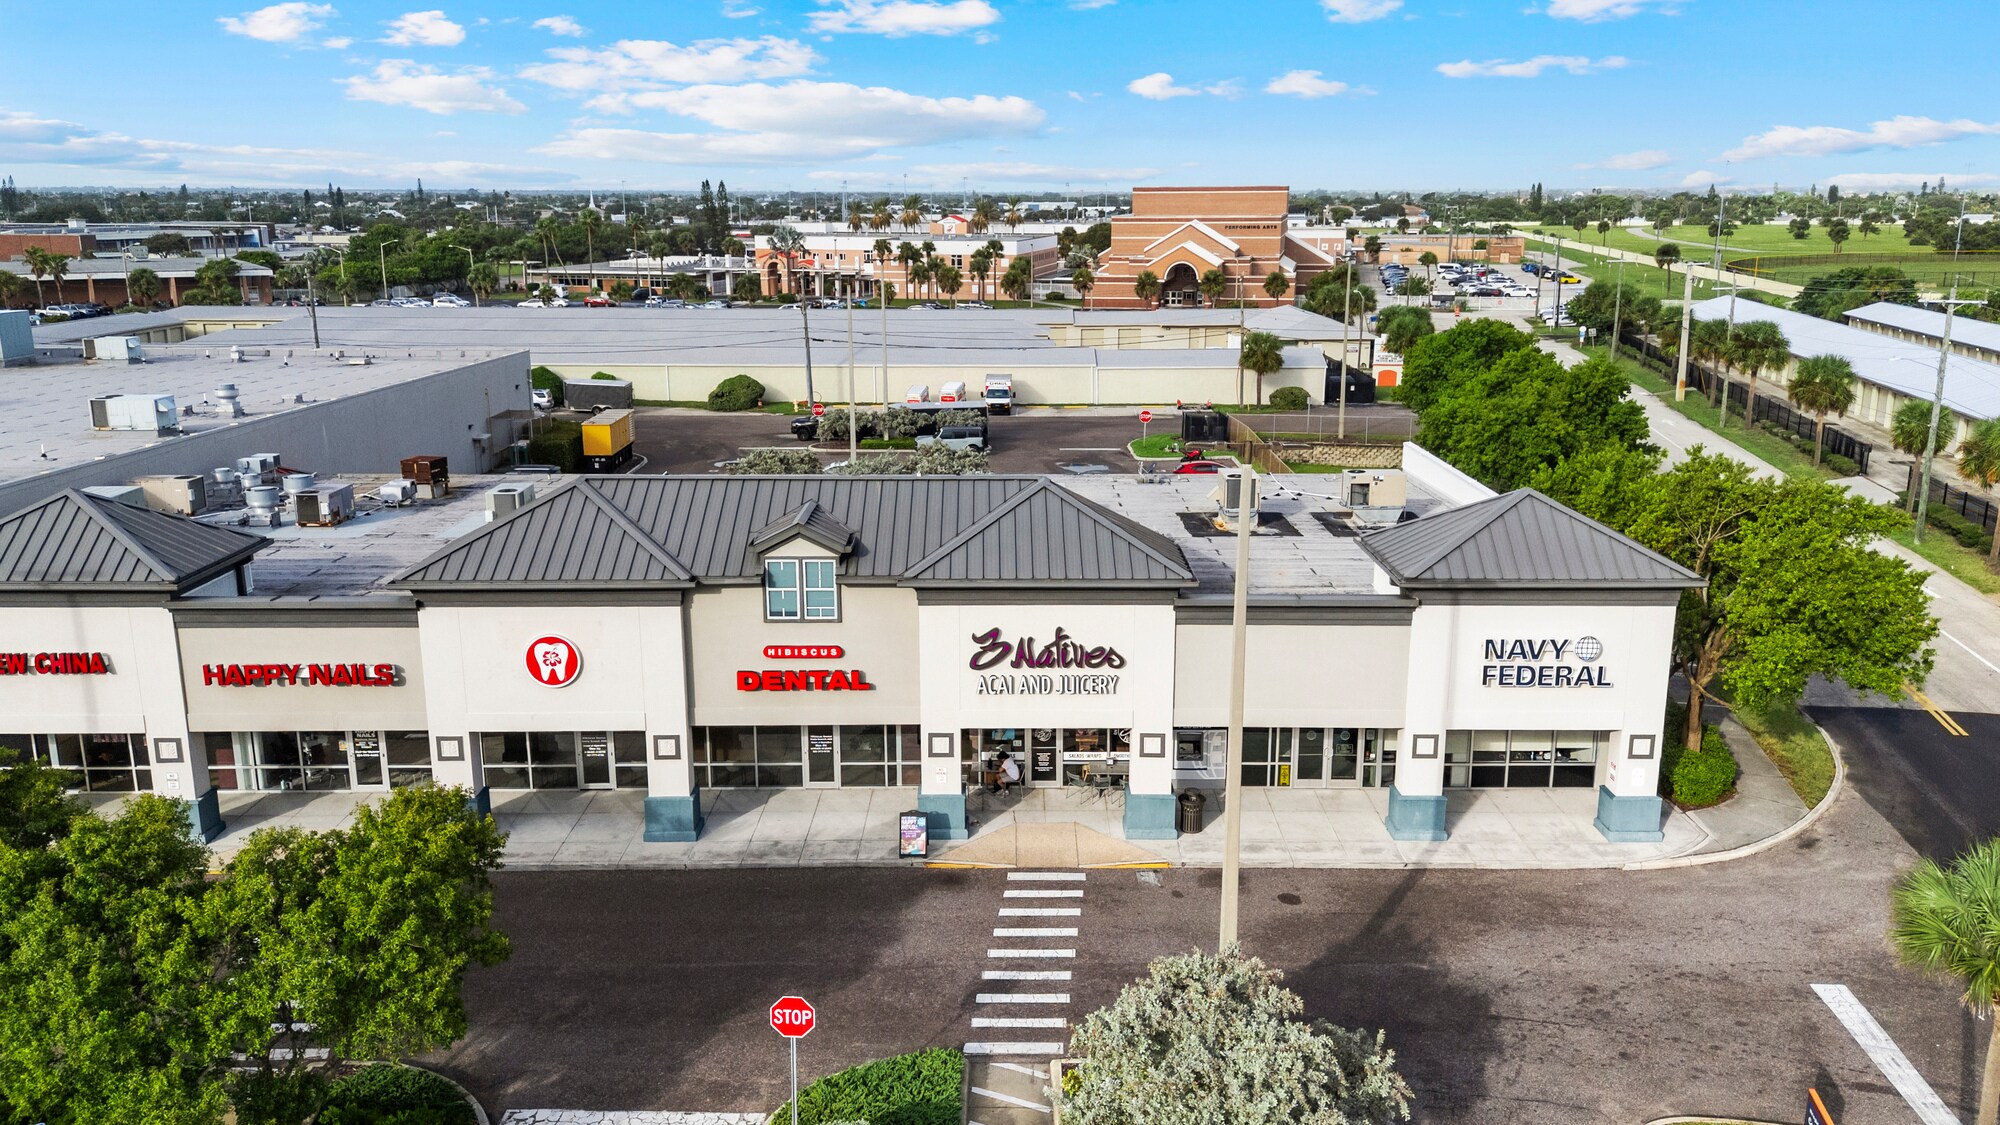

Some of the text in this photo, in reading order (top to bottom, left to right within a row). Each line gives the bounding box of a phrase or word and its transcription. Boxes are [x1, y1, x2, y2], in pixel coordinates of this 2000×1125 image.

[767, 648, 837, 656] HIBISCUS
[969, 626, 1126, 670] 3 Natives
[1484, 639, 1570, 660] NAVY
[34, 652, 107, 675] CHINA
[203, 663, 394, 686] HAPPY NAILS
[737, 670, 870, 691] DENTAL
[977, 675, 1119, 695] ACAI AND JUICERY
[1482, 665, 1612, 687] FEDERAL
[773, 1008, 812, 1025] STOP
